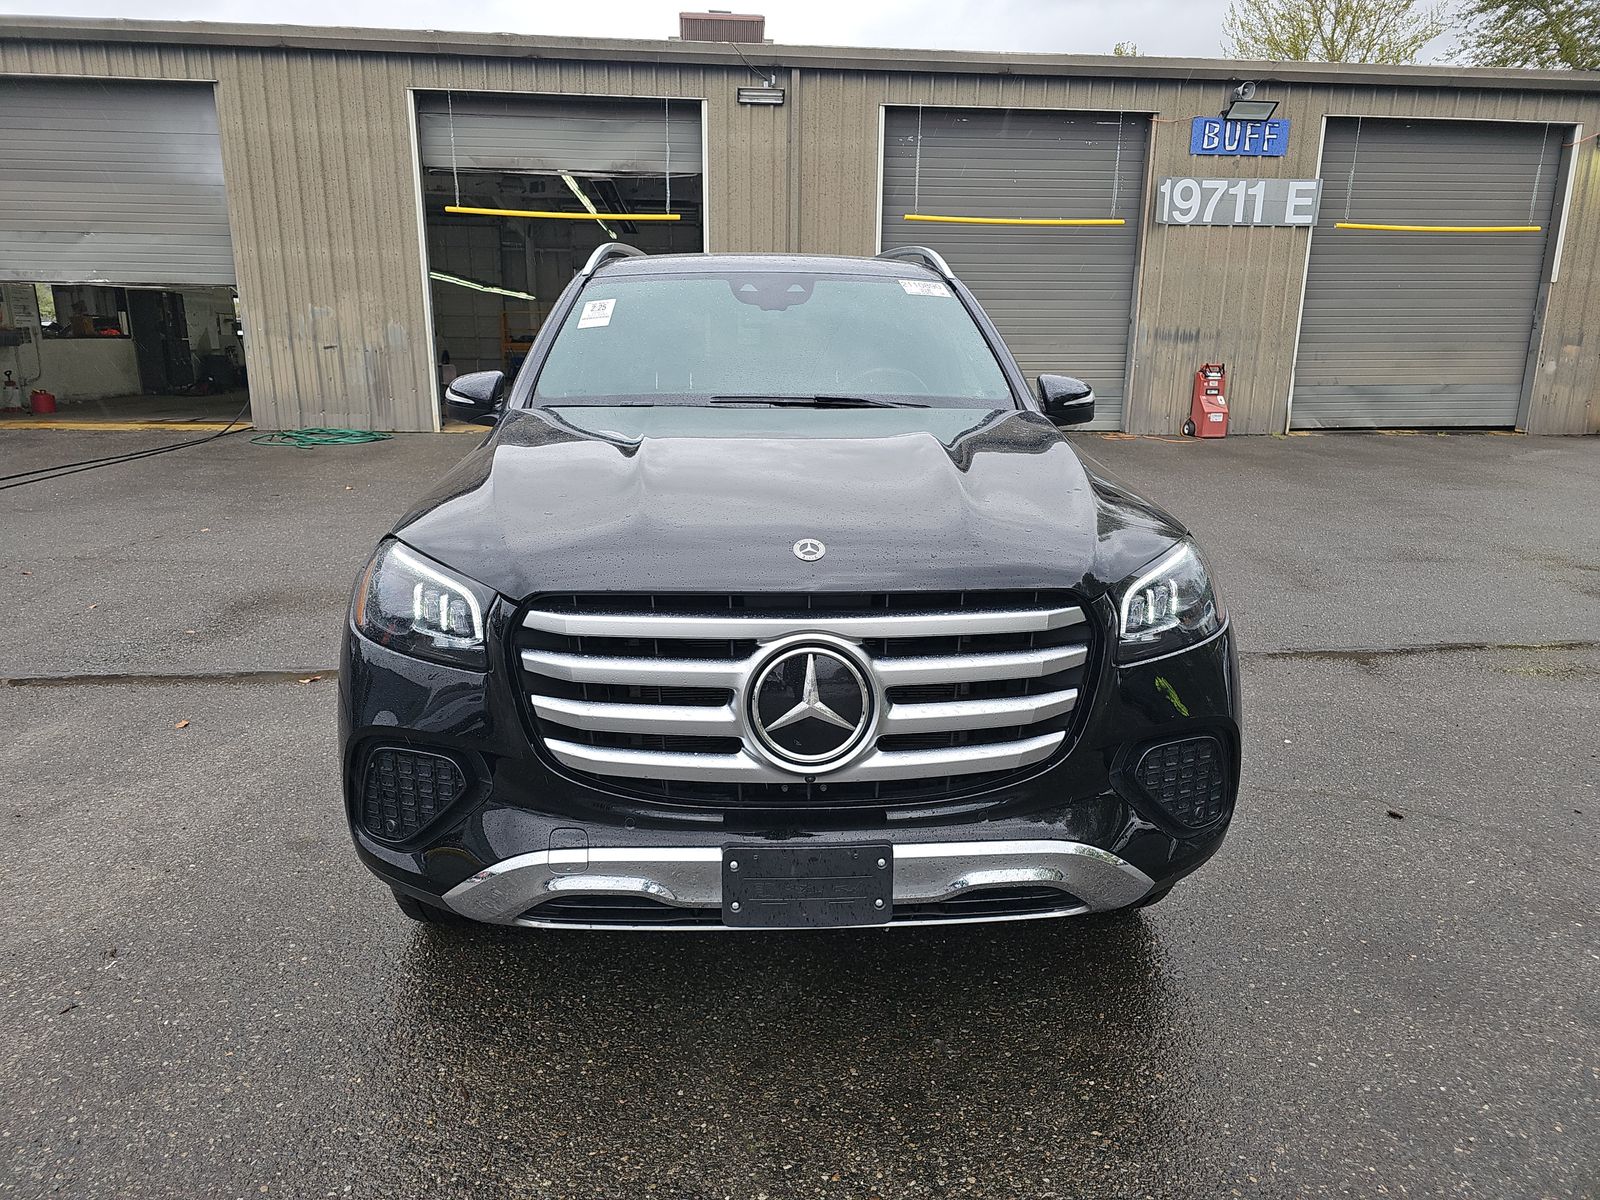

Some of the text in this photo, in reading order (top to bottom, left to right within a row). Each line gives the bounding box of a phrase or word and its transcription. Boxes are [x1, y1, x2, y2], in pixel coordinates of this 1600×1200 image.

[1202, 121, 1280, 151] BUFF
[1160, 178, 1317, 224] 19711 E
